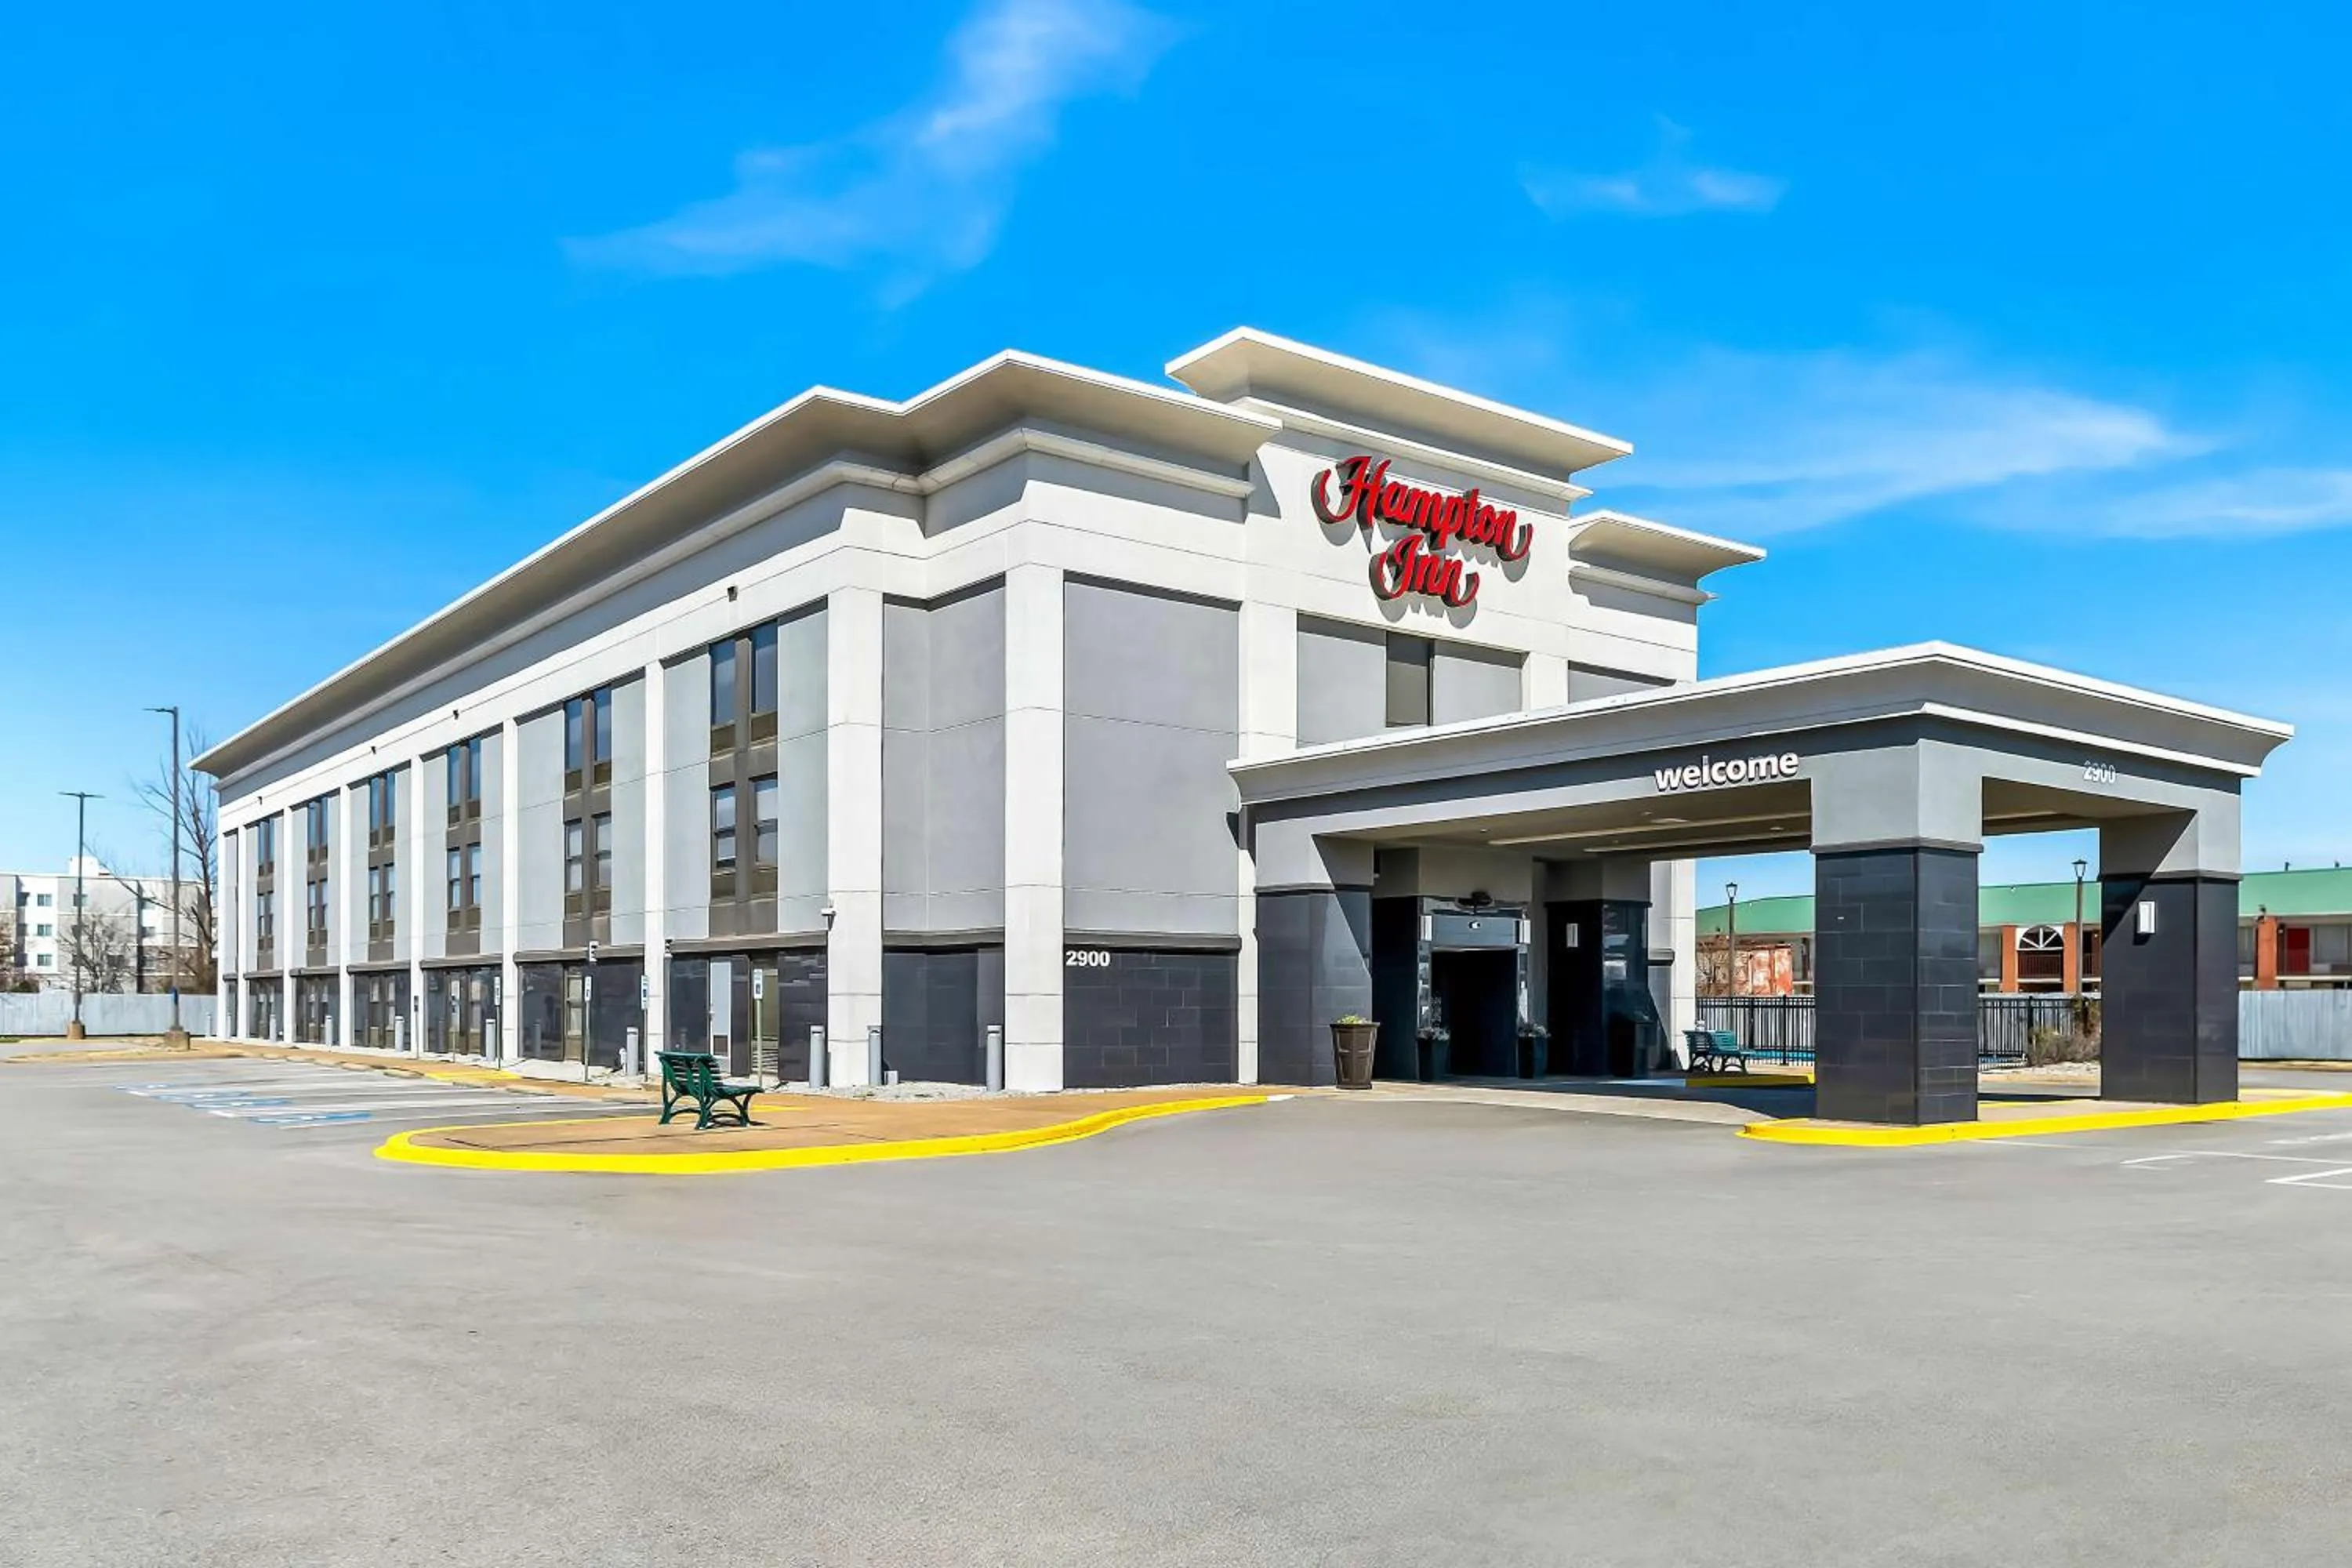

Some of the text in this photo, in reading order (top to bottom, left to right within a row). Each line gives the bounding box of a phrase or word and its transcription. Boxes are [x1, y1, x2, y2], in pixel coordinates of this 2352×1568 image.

[1312, 455, 1533, 562] Hampton
[1370, 534, 1479, 608] Inn
[1655, 752, 1799, 790] welcome
[2084, 760, 2116, 783] 2900
[1066, 950, 1110, 967] 2900
